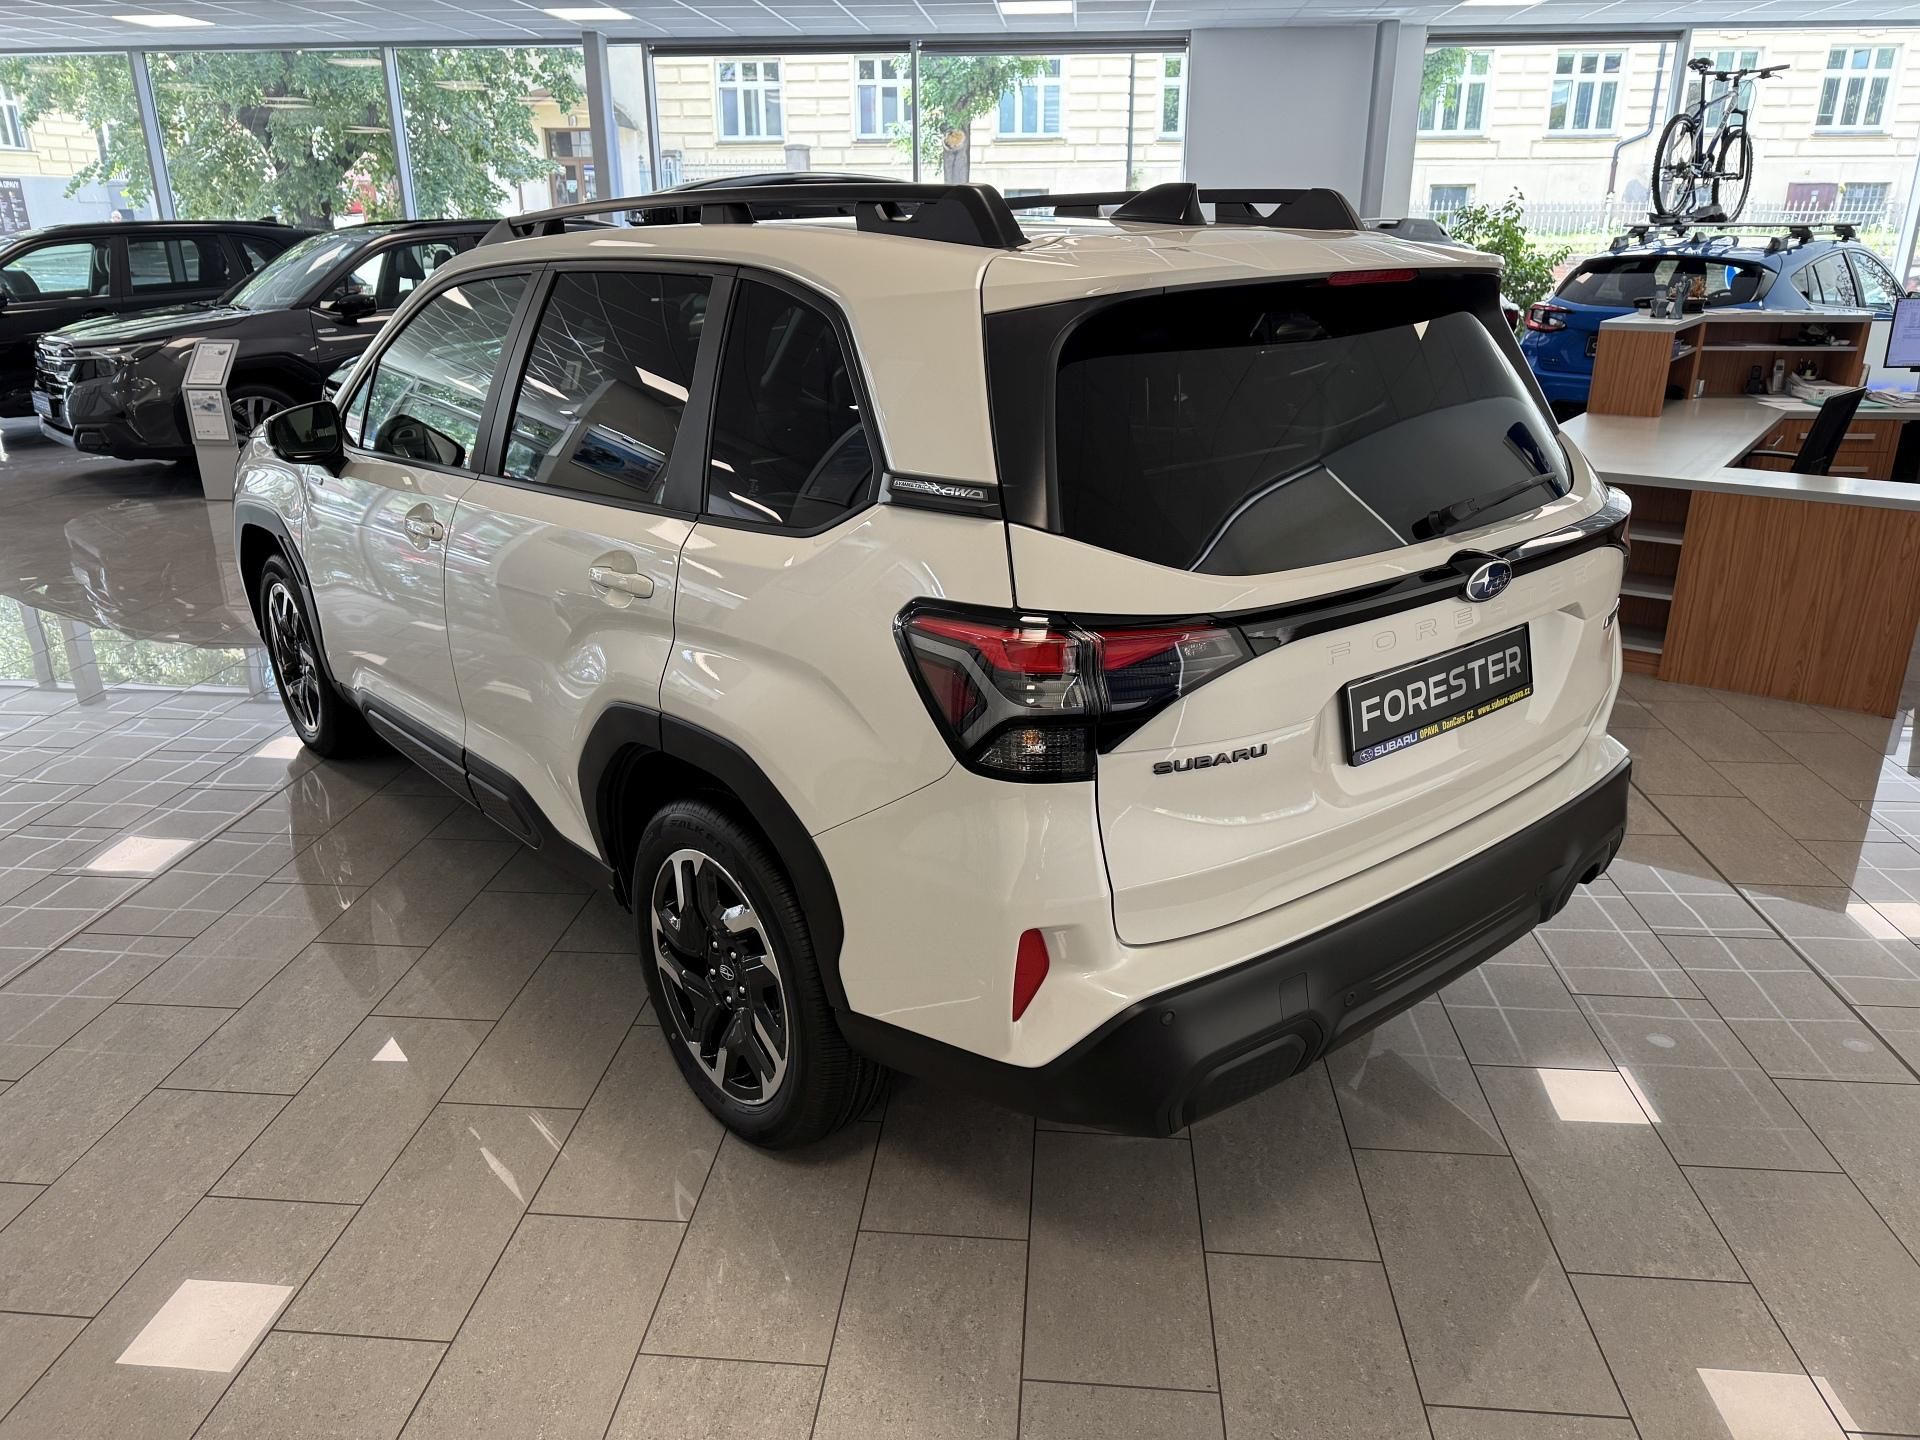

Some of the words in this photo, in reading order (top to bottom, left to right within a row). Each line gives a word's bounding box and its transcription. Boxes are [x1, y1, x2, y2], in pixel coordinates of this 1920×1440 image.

[1361, 646, 1521, 733] FORESTER
[1374, 732, 1418, 757] SUBARU
[1419, 724, 1439, 739] OPAVA
[1466, 710, 1475, 721] CZ
[1153, 743, 1268, 775] SUBARU
